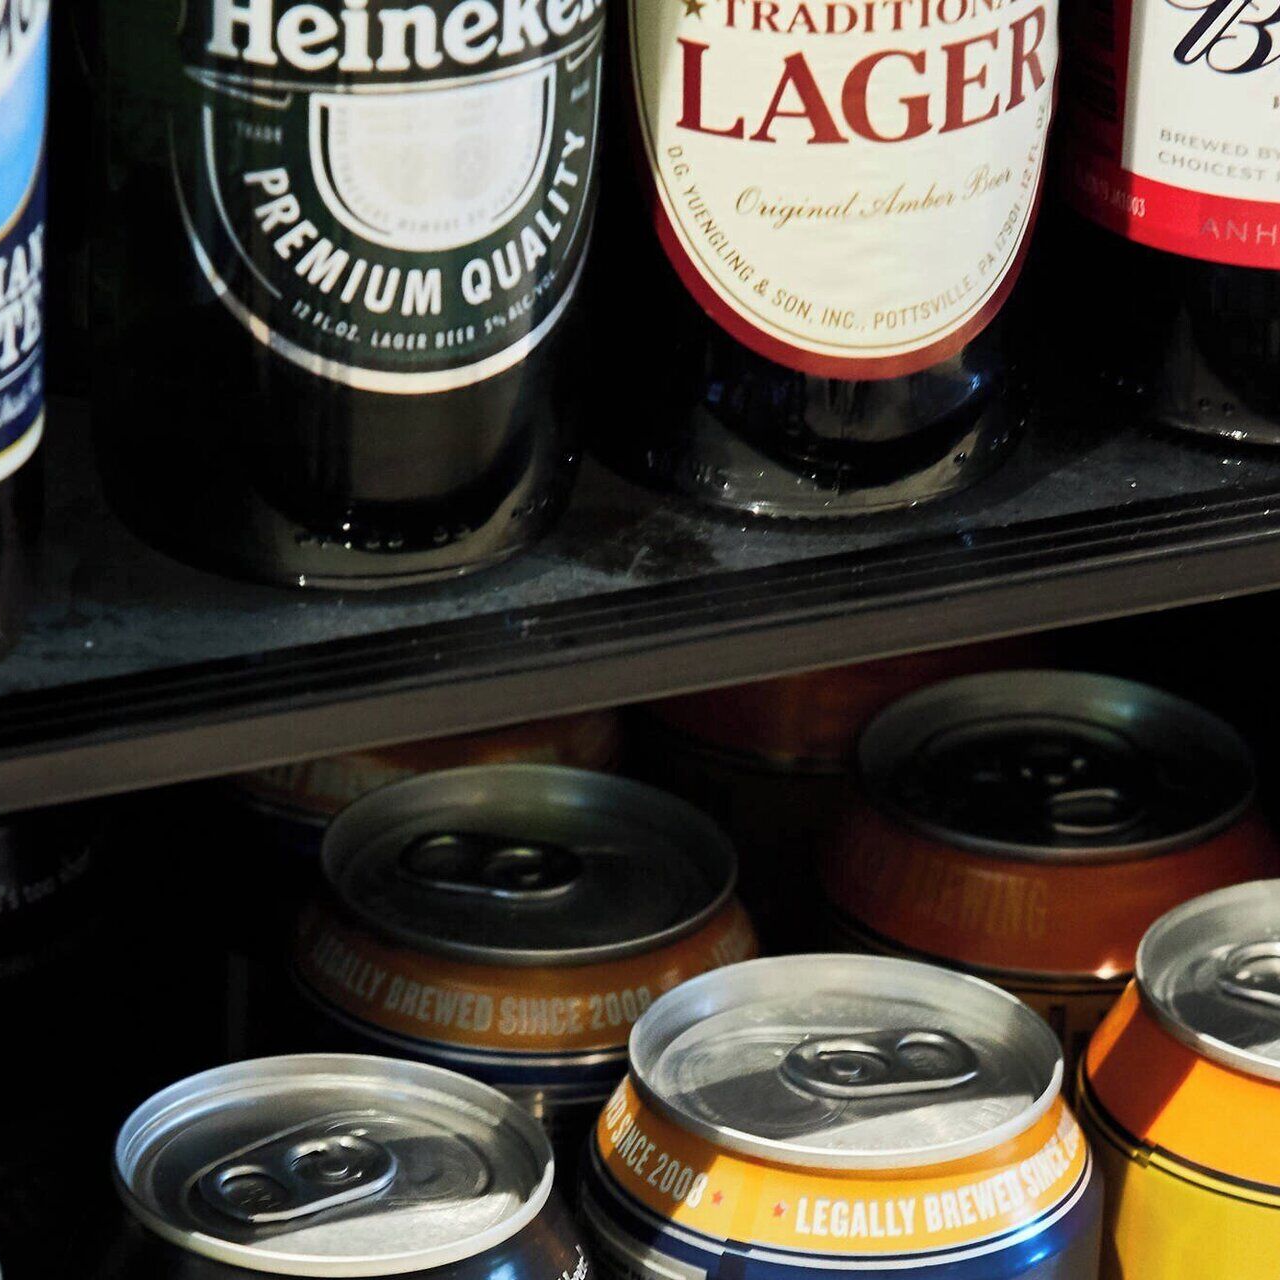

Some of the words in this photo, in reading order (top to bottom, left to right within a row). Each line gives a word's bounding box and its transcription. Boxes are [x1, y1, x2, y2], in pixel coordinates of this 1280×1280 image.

[719, 0, 1022, 34] TRADITION
[676, 3, 1048, 145] LAGER
[1157, 149, 1266, 182] CHOICEST
[1159, 127, 1250, 158] BREWED
[242, 166, 442, 317] PREMIUM
[461, 129, 586, 305] QUALITY
[735, 185, 859, 230] Original
[859, 182, 956, 219] Amber
[962, 163, 1013, 200] Beer
[683, 184, 756, 283] YUENGLING
[753, 278, 770, 297] &
[371, 327, 427, 350] LAGER
[435, 323, 476, 349] BEER
[384, 975, 495, 1033] BREWED
[498, 996, 584, 1037] SINCE
[610, 1112, 657, 1176] SINCE
[646, 1152, 709, 1209] 2008
[795, 1197, 916, 1238] LEGALLY
[923, 1167, 1025, 1234] BREWED
